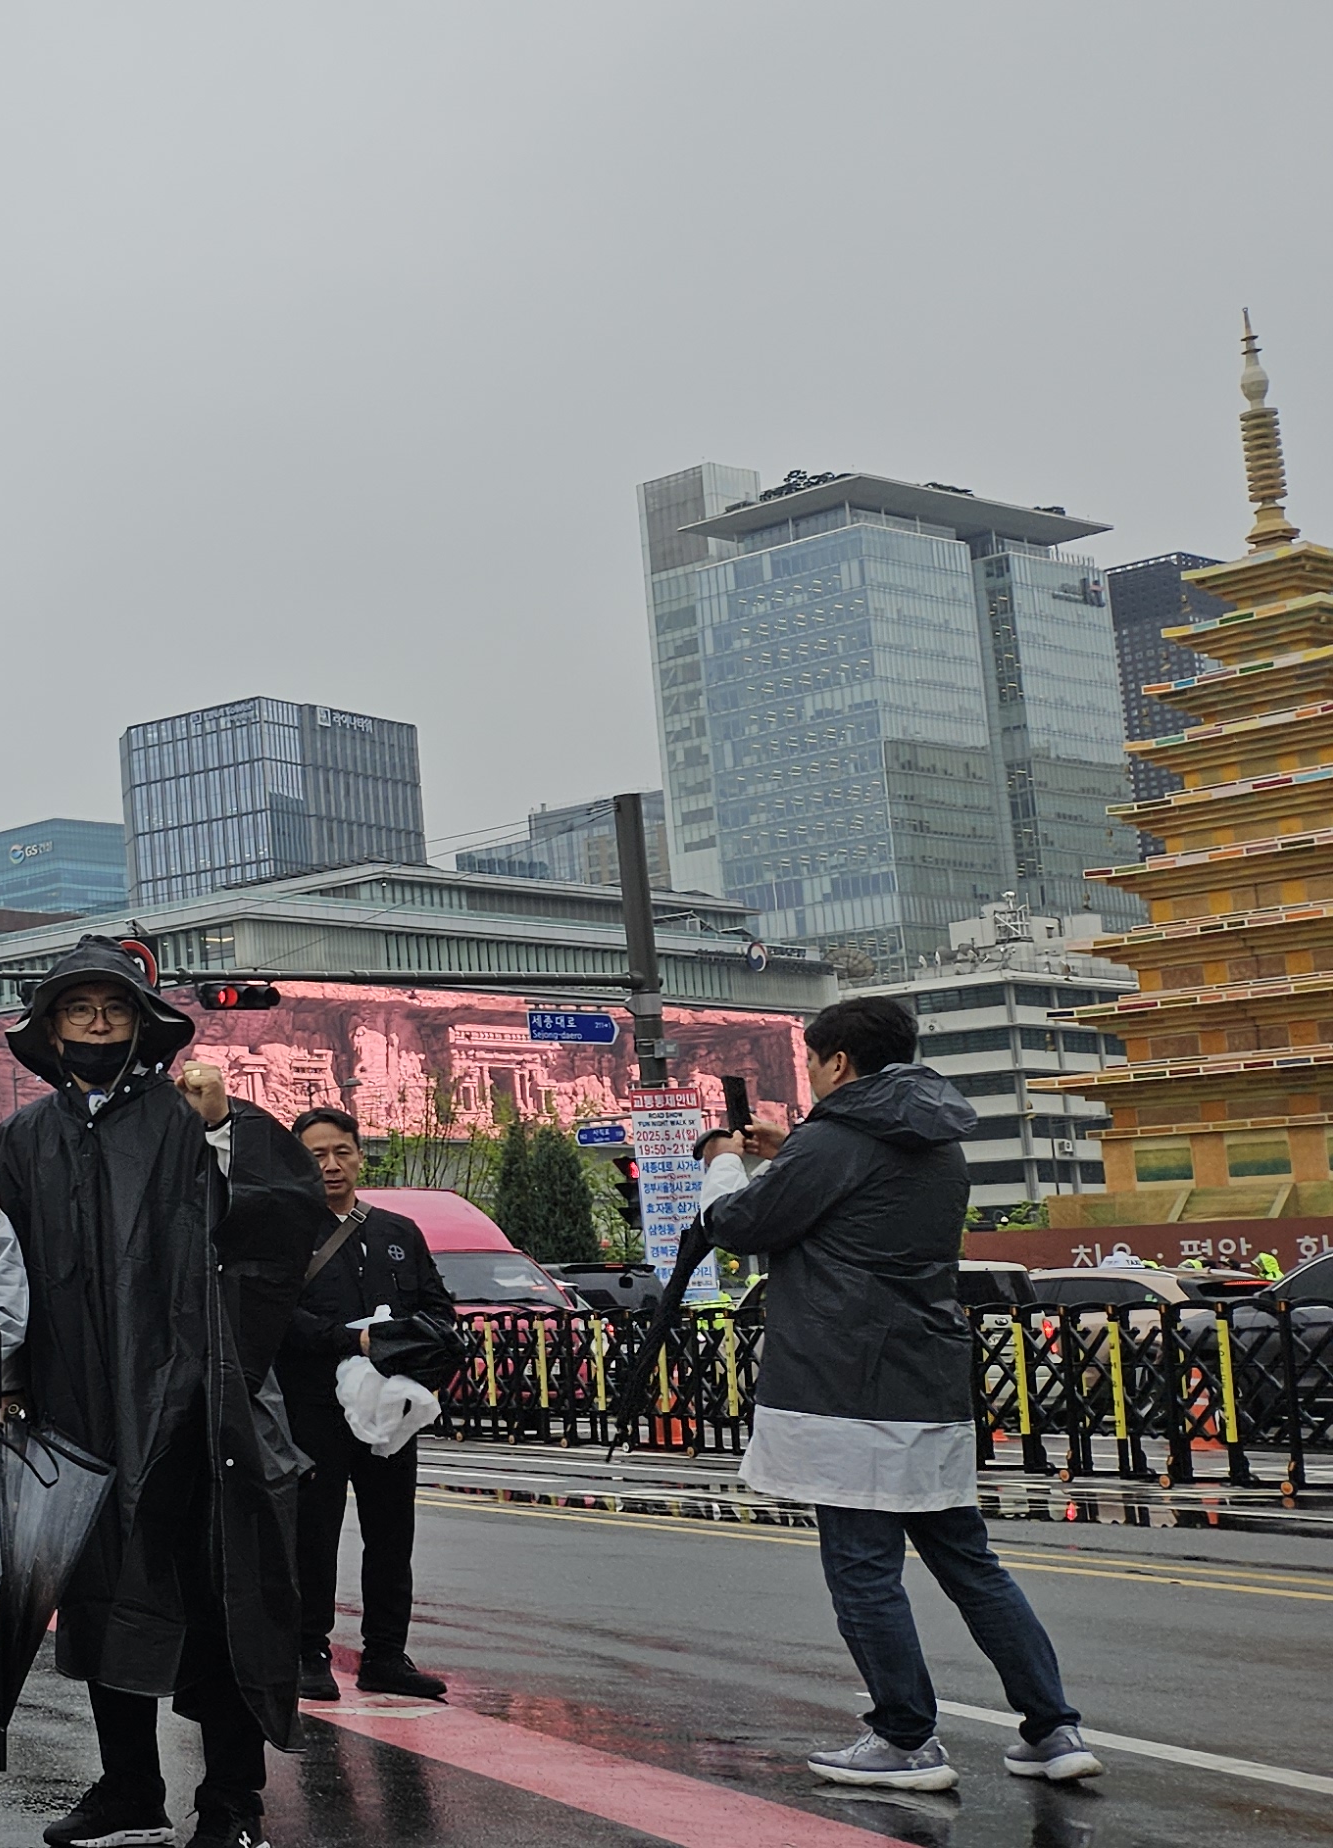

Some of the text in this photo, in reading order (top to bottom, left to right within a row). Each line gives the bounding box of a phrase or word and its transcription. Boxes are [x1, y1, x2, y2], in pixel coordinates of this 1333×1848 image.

[532, 1014, 577, 1029] 세종대로
[532, 1030, 583, 1040] Sejong-daero
[633, 1093, 698, 1108] 교통통제안내
[642, 1161, 674, 1173] 세종대로
[646, 1202, 673, 1214] 효자동
